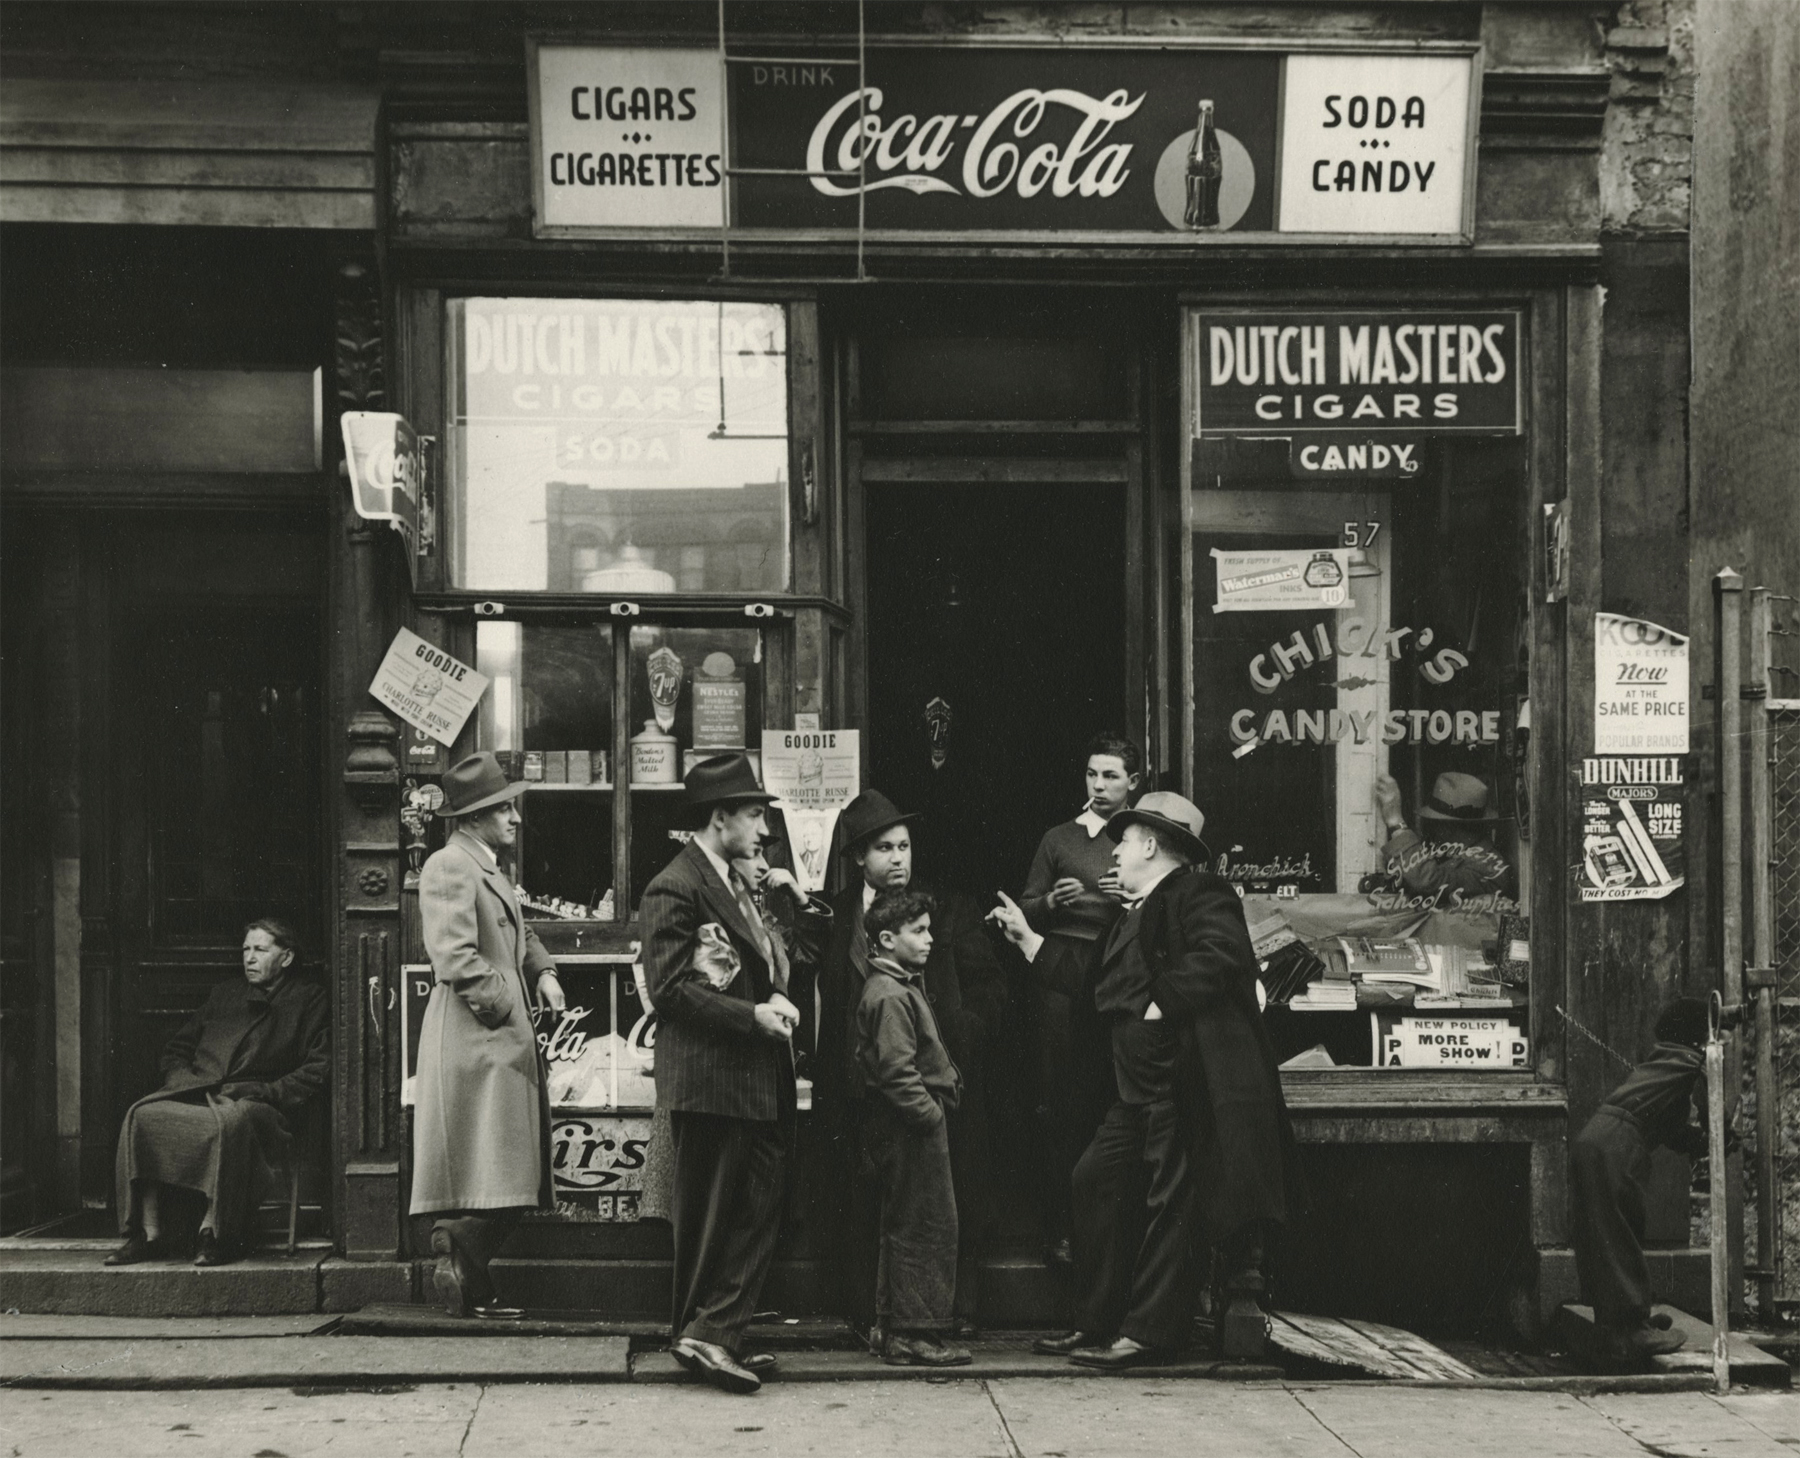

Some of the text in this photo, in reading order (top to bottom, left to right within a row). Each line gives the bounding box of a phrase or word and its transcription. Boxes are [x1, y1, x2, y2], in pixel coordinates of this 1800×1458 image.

[753, 67, 835, 86] DRINK
[571, 87, 697, 121] CIGARS
[1323, 95, 1426, 129] SODA
[806, 87, 1148, 198] Coca-Cola
[550, 152, 721, 187] CIGARETTES
[1312, 159, 1436, 193] CANDY
[466, 314, 768, 378] DUTCH MASTERS
[1210, 324, 1507, 386] DUTCH MASTERS
[512, 384, 722, 412] CIGARS
[1255, 393, 1459, 420] CIGARS
[565, 435, 671, 462] SODA
[1300, 444, 1415, 471] CANDY
[1344, 522, 1381, 548] 57
[1246, 557, 1271, 565] SUPPLY
[1221, 566, 1301, 592] Waterman's
[1280, 584, 1302, 593] INKS
[415, 643, 467, 682] GOODIE
[1249, 617, 1469, 694] CHICK'S
[382, 681, 424, 716] CHARLOTTE
[426, 711, 452, 731] RUSSE
[1626, 690, 1658, 698] AT THE
[1599, 702, 1685, 716] SAME PRICE
[1231, 708, 1500, 745] CANDY STORE
[785, 734, 836, 748] GOODIE
[1599, 734, 1685, 748] POPULAR BRANDS
[636, 757, 665, 765] Malted
[638, 765, 659, 773] Milk
[1583, 758, 1683, 784] DUNHILL
[825, 788, 849, 797] RUSSE
[1611, 789, 1654, 798] MAJORS
[1584, 807, 1611, 815] LONGER
[1648, 803, 1682, 818] LONG
[1584, 825, 1611, 833] BETTER
[1648, 819, 1682, 834] SIZE
[1217, 852, 1314, 880] Aronchick
[1387, 841, 1510, 880] Stationery
[1368, 884, 1448, 913] School
[1583, 889, 1606, 898] THEY
[1608, 889, 1632, 897] COST
[1634, 889, 1648, 897] NO
[1414, 1020, 1497, 1030] NEW POLICY
[1418, 1034, 1469, 1046] MORE
